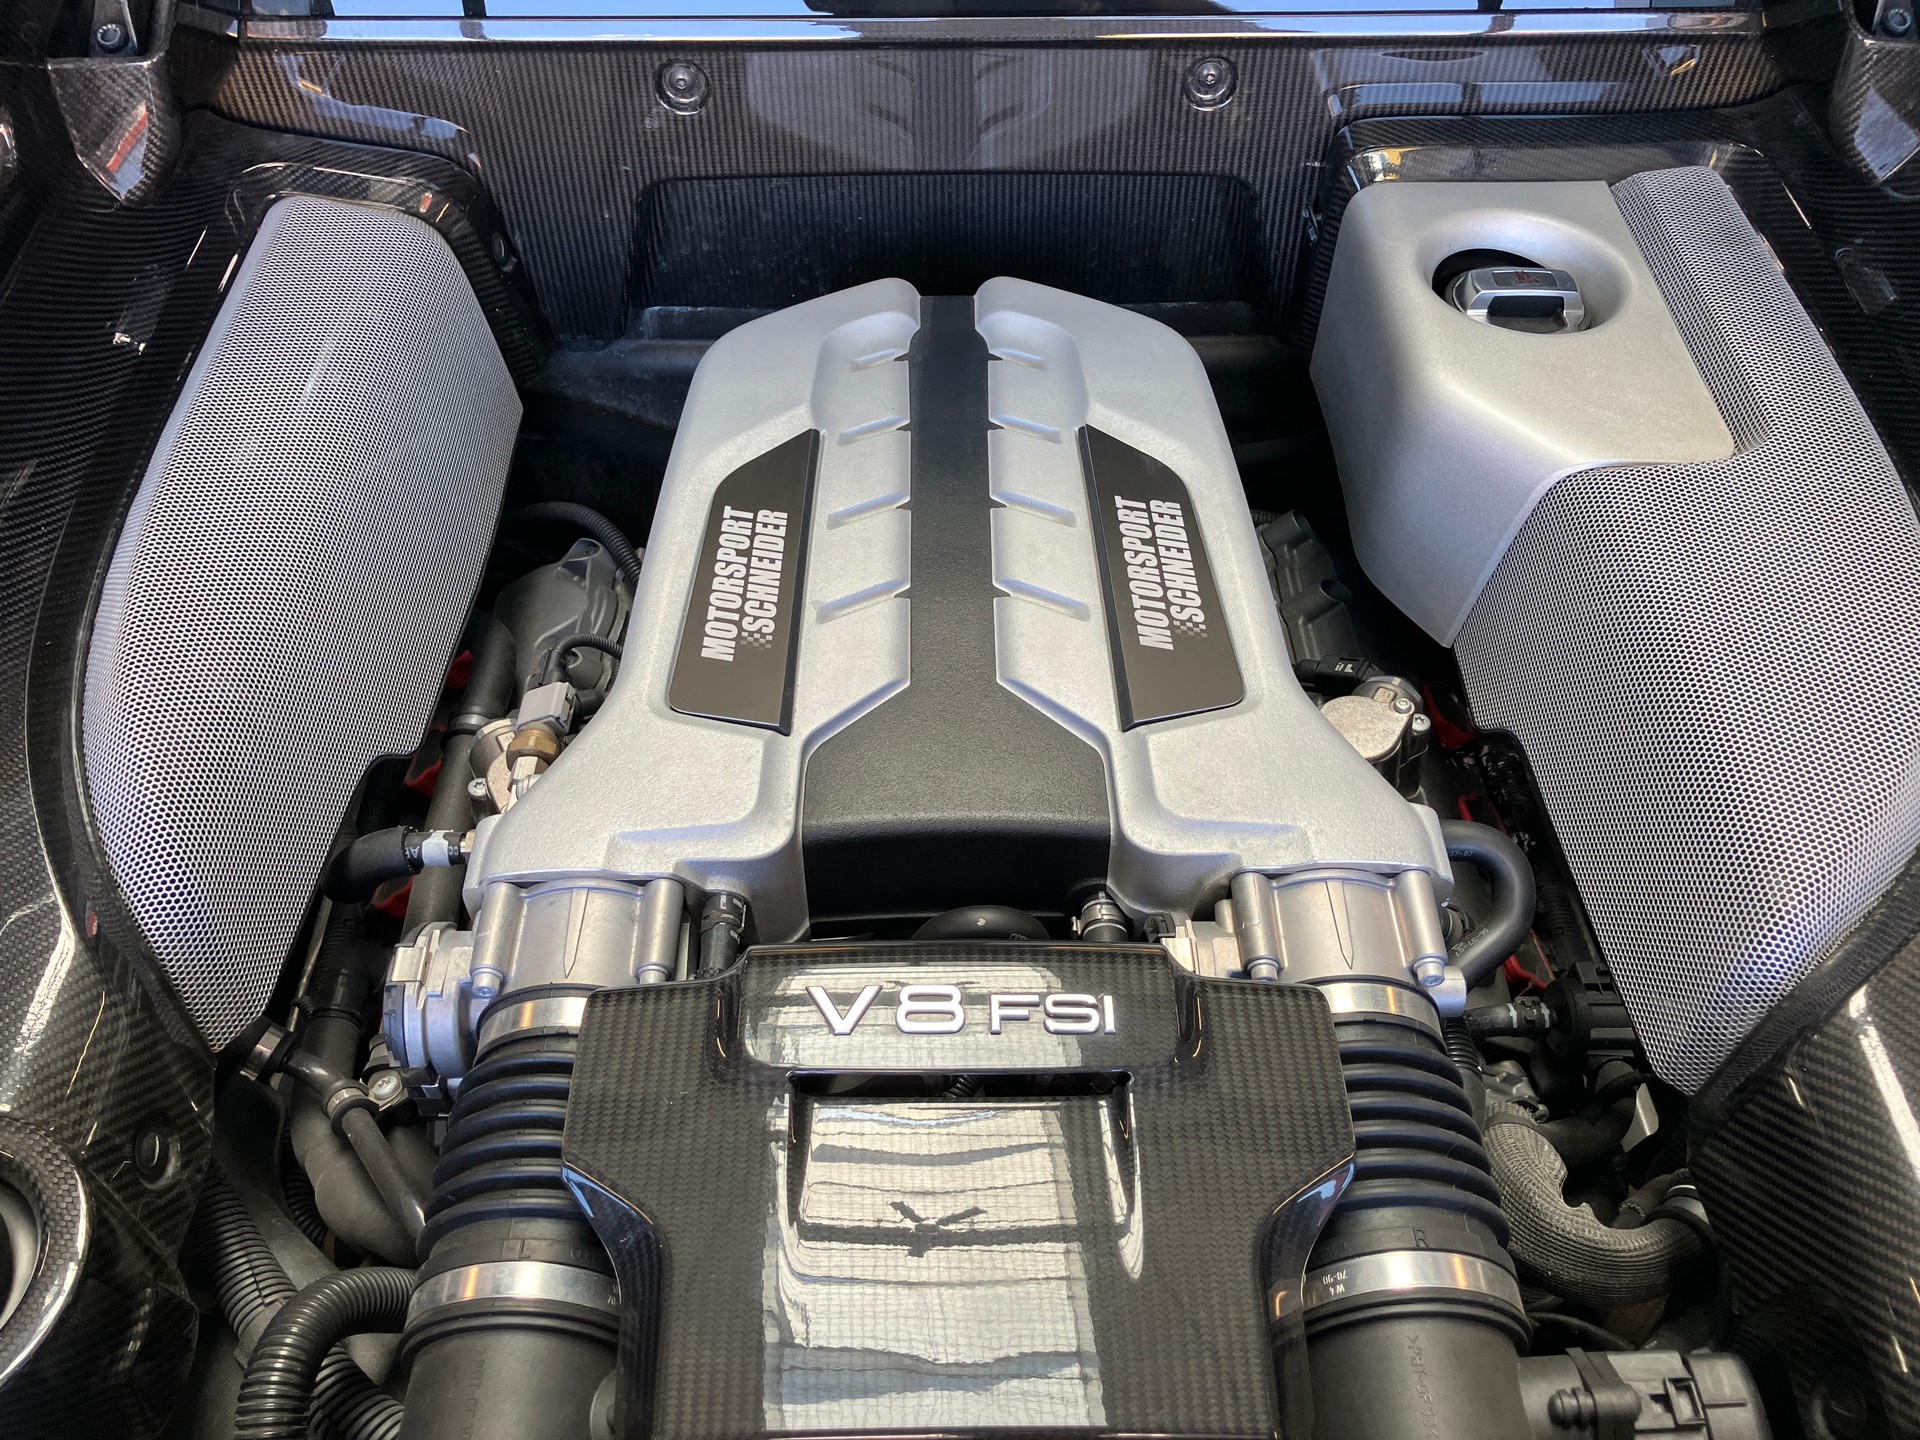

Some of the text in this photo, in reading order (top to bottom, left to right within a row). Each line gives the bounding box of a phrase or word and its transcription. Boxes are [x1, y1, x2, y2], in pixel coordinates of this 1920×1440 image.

[701, 505, 754, 662] MOTORSPORT
[741, 509, 788, 634] SCHNEIDER
[1114, 495, 1174, 651] MOTORSPORT
[1149, 499, 1205, 623] SCHNEIDER
[989, 993, 1116, 1036] FSI
